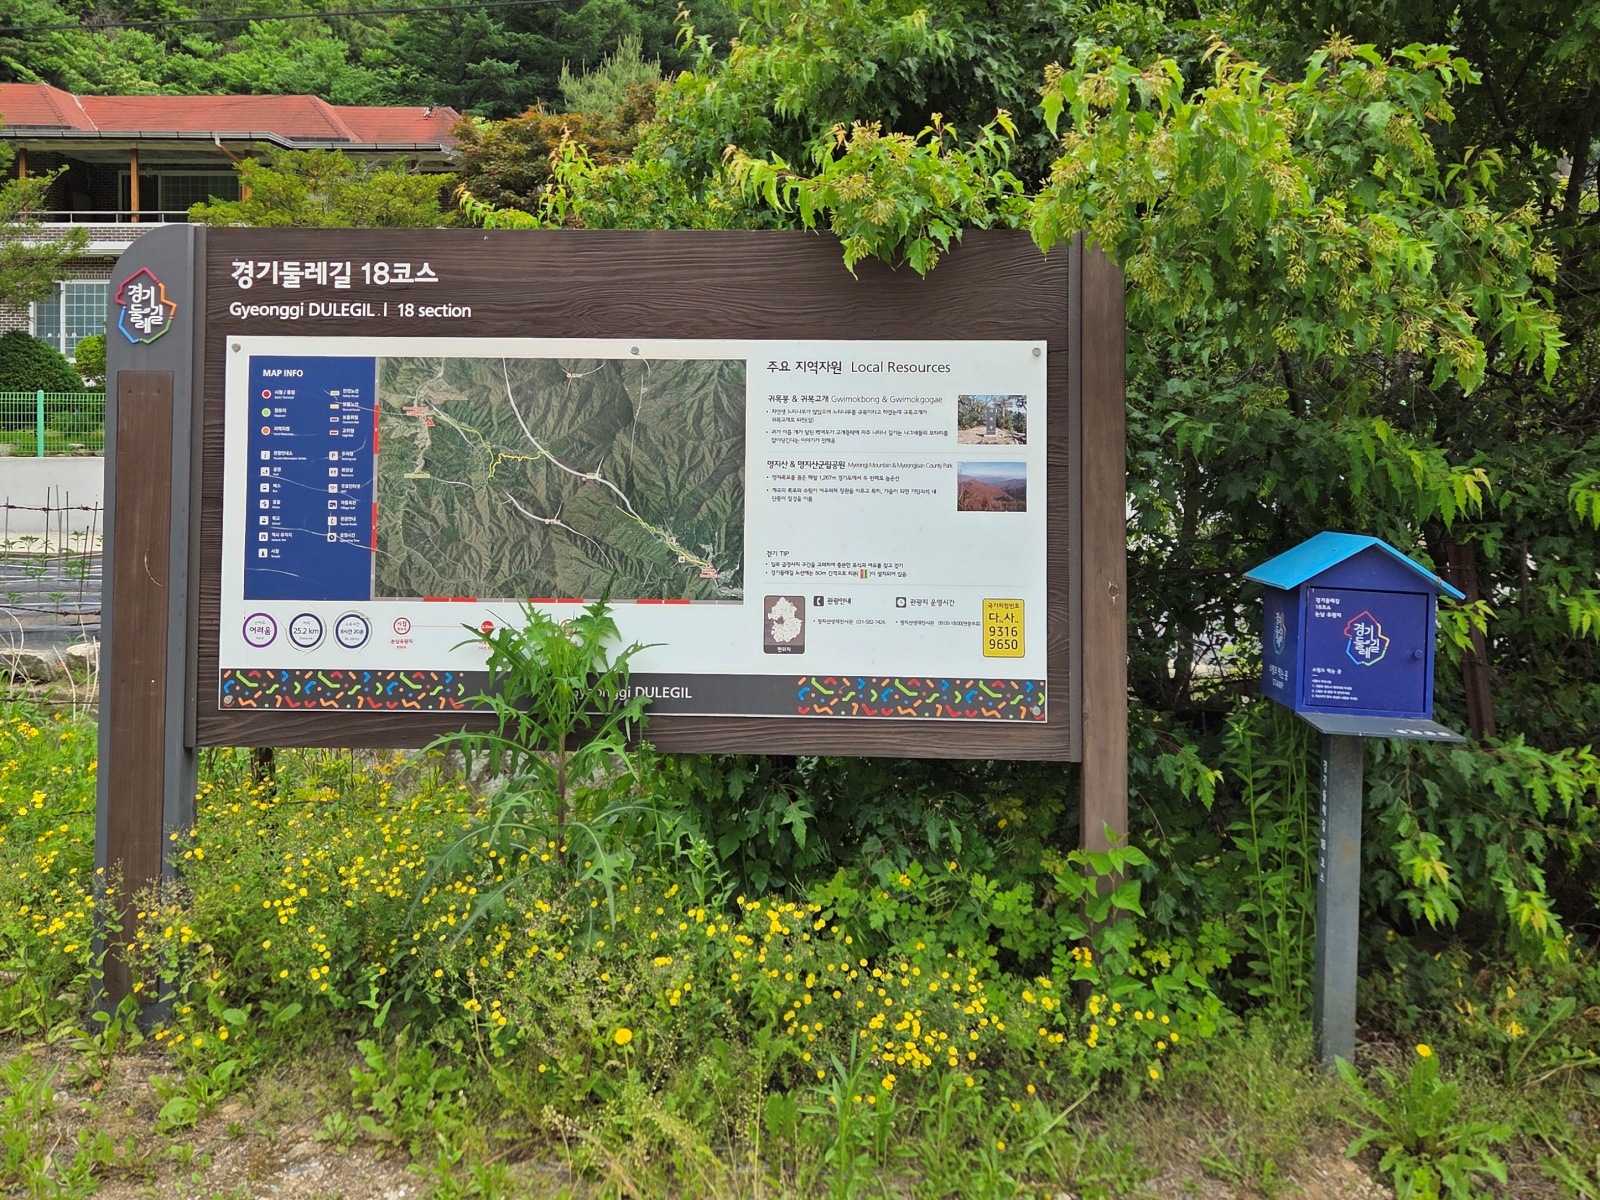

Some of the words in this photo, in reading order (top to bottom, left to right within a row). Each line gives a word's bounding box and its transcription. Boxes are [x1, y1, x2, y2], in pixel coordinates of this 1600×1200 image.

[231, 261, 351, 289] 경기둘레길
[361, 262, 438, 286] 18코스
[229, 302, 304, 319] Gyeonggi
[309, 302, 375, 317] DULEGIL
[398, 303, 414, 318] 18
[418, 303, 472, 318] section
[767, 361, 791, 373] 주요
[795, 361, 842, 375] 지역자원
[851, 361, 883, 373] Local
[887, 361, 951, 373] Resources
[262, 369, 283, 378] MAP
[284, 369, 304, 378] INFO
[768, 395, 789, 404] 귀목봉
[800, 395, 829, 404] 귀목고개
[831, 395, 880, 404] Gwimokbong
[890, 396, 943, 404] Gwimokgogae
[767, 460, 788, 469] 명지산
[797, 460, 845, 469] 명지산군립공원
[767, 550, 778, 558] 걷기
[827, 597, 852, 605] 관광안내
[910, 598, 928, 606] 관광지
[930, 599, 955, 607] 운영시간
[988, 602, 1020, 610] 국가지점번호
[249, 626, 272, 636] 어려움
[293, 627, 308, 635] 25.2
[989, 626, 1018, 637] 9316
[989, 639, 1018, 650] 9650
[635, 686, 692, 698] DULEGIL
